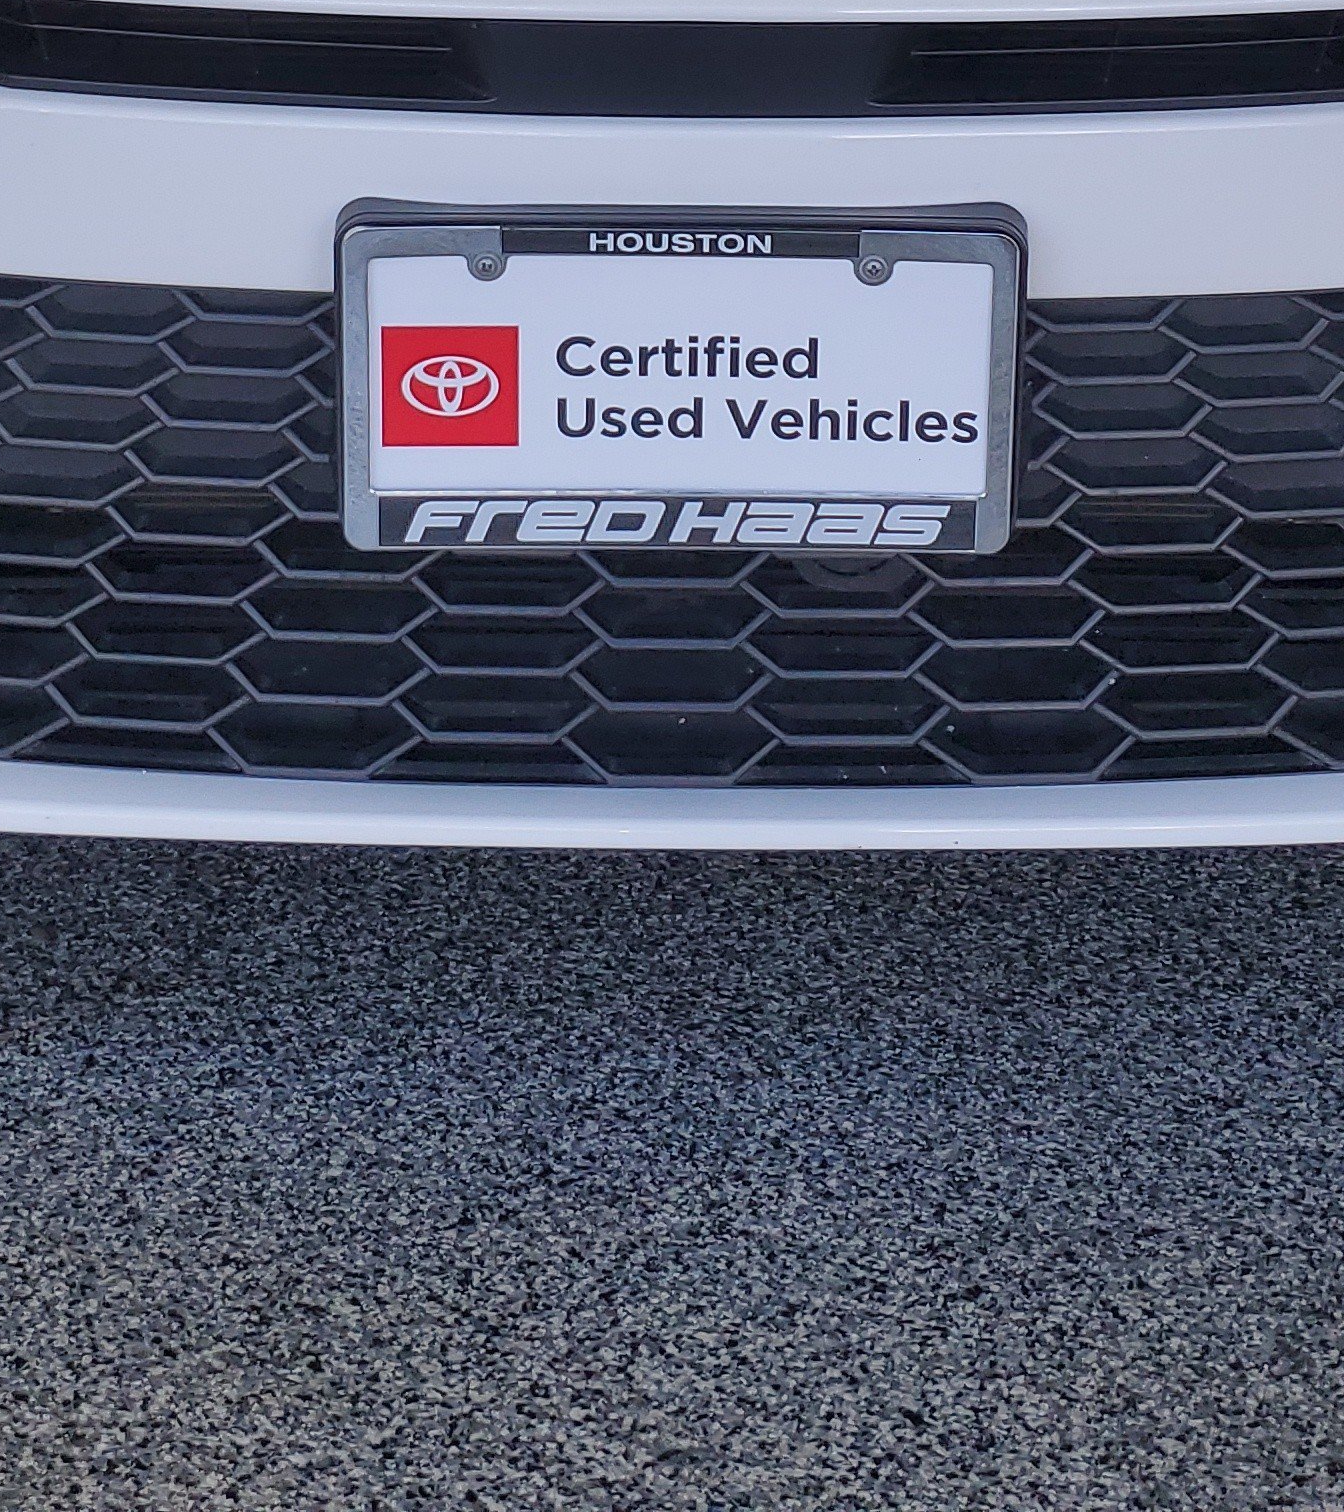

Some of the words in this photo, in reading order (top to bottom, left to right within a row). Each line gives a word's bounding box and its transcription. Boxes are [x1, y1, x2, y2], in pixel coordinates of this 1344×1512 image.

[589, 232, 772, 254] HOUSTON
[555, 335, 819, 379] Certified
[557, 396, 704, 439] Used
[725, 398, 979, 444] Vehicles
